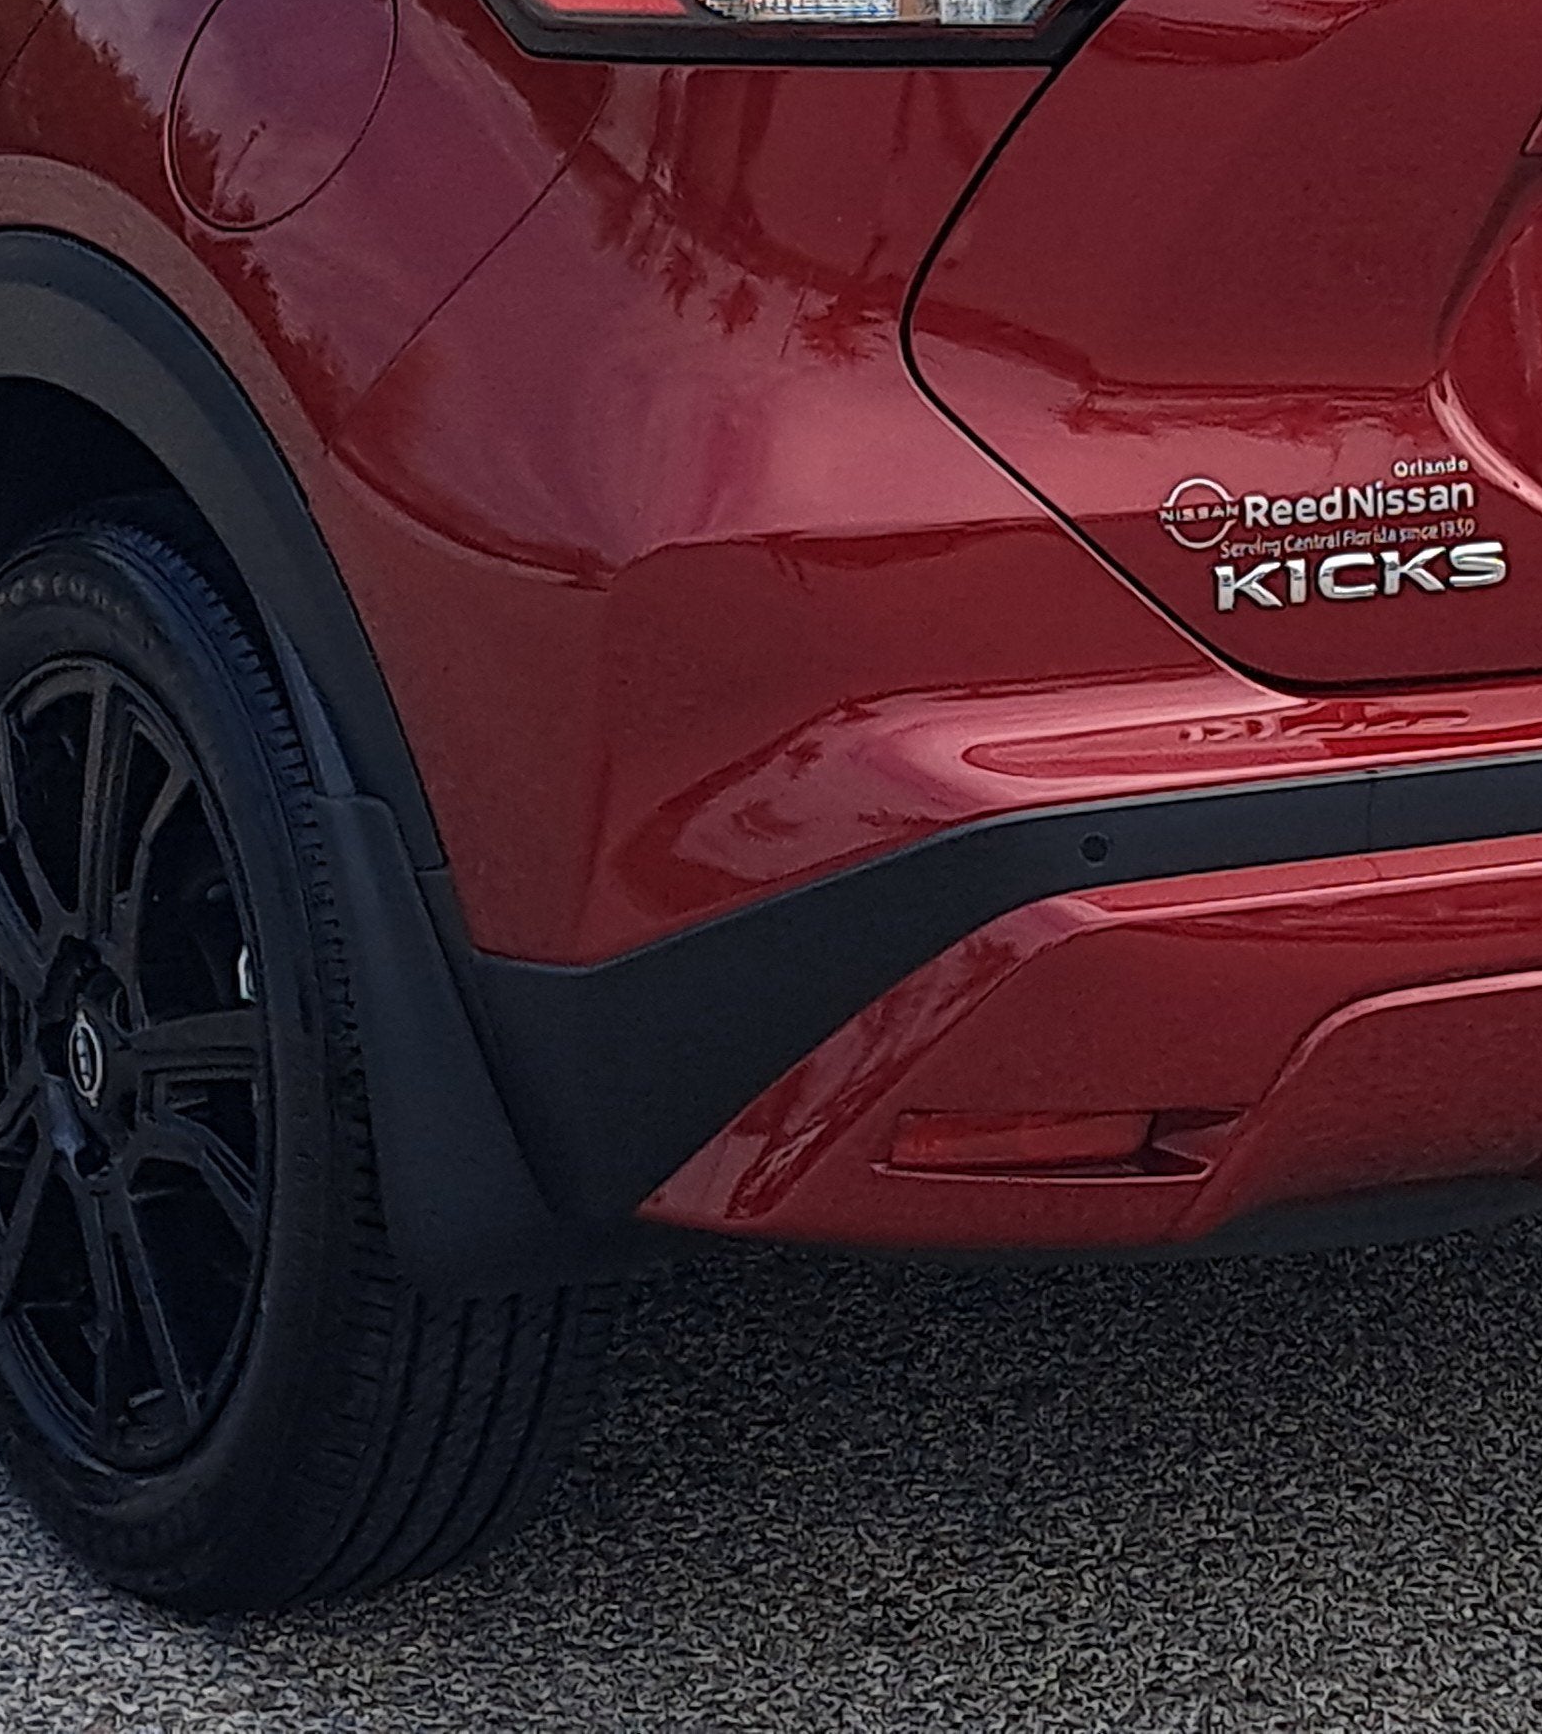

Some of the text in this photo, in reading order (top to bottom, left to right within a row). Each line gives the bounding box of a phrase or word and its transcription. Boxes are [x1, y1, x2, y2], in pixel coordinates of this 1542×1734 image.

[1393, 455, 1469, 478] Orlando
[1158, 504, 1240, 522] NISSAN
[1220, 533, 1282, 559] Serving
[1284, 530, 1341, 553] Central
[1343, 523, 1397, 547] Florida
[1214, 542, 1506, 612] KICKS
